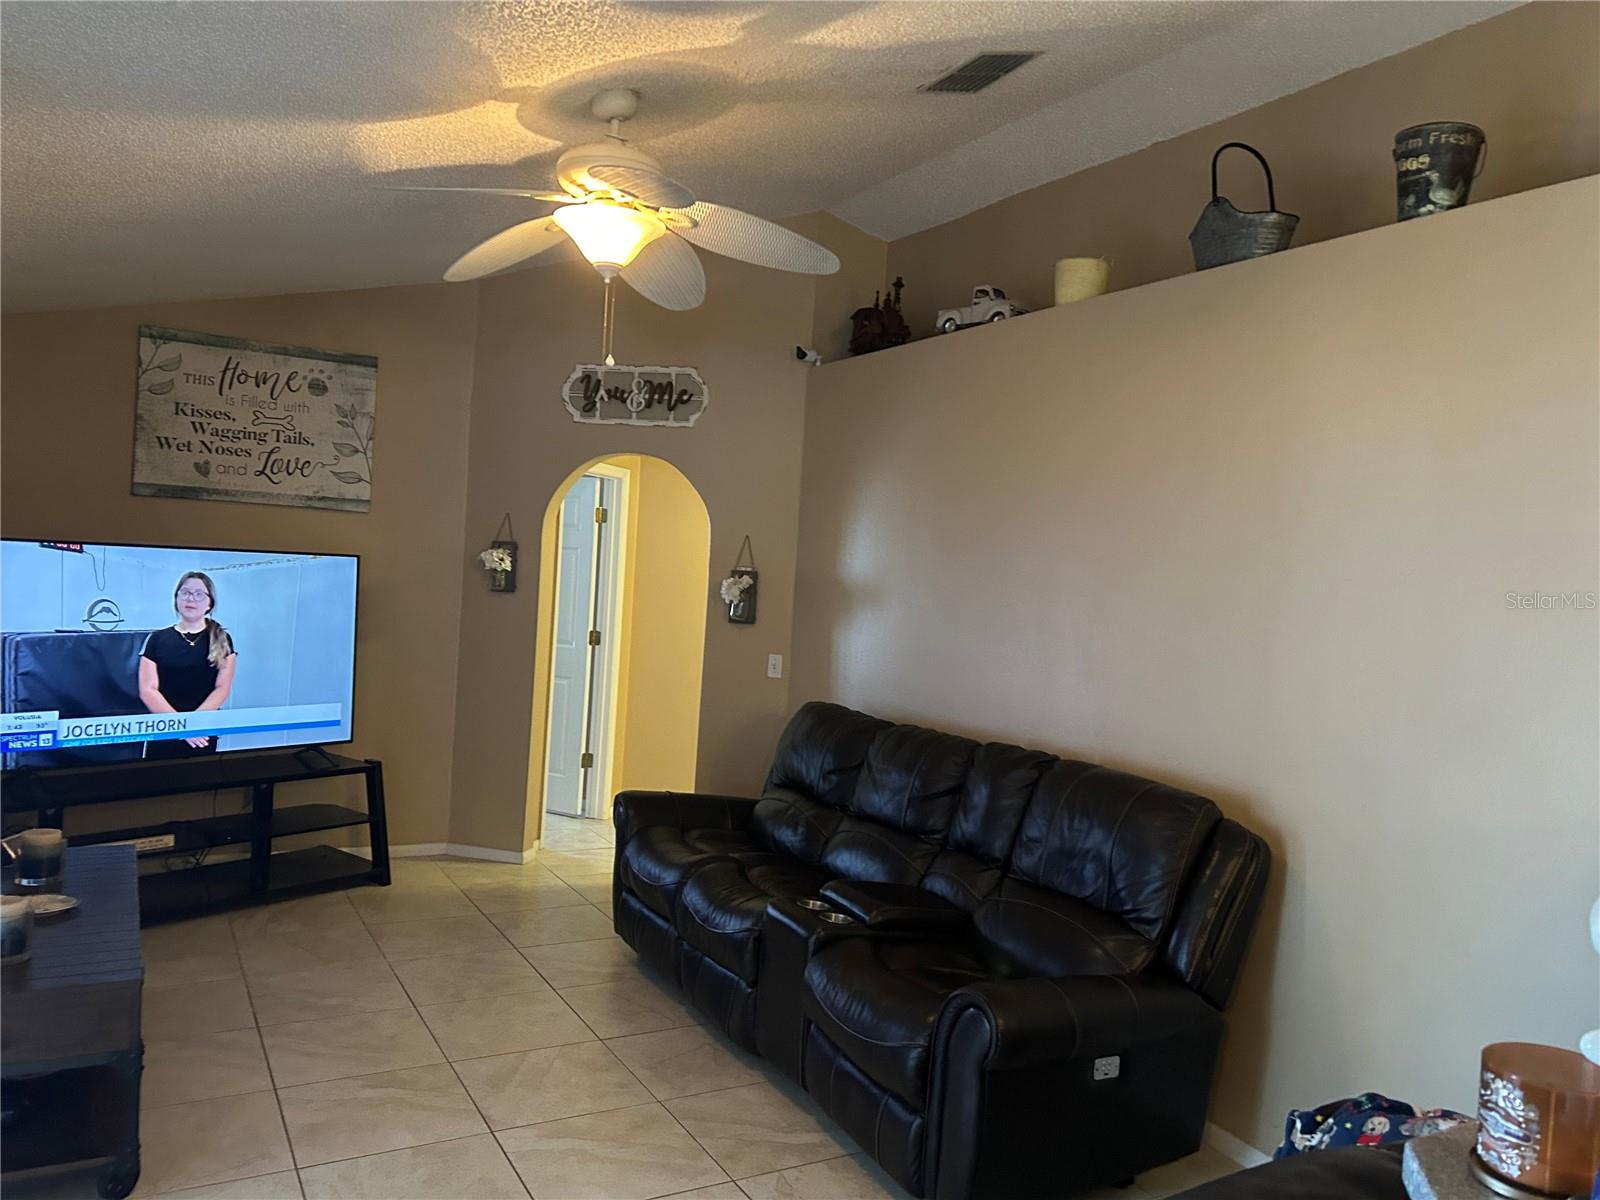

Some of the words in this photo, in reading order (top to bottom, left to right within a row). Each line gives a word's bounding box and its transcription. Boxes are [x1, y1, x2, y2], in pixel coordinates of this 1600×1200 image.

[183, 373, 215, 386] THIS
[219, 356, 302, 400] Home
[225, 394, 235, 406] is
[283, 401, 310, 413] with
[580, 374, 634, 412] You
[627, 378, 647, 411] &
[644, 380, 693, 411] Me
[191, 421, 268, 445] Wagging
[155, 436, 192, 453] Wet
[200, 440, 252, 457] Noses
[216, 464, 247, 476] and
[254, 447, 316, 484] Love
[63, 722, 131, 738] JOCELYN
[136, 719, 187, 733] THORN
[9, 739, 37, 748] NEWS
